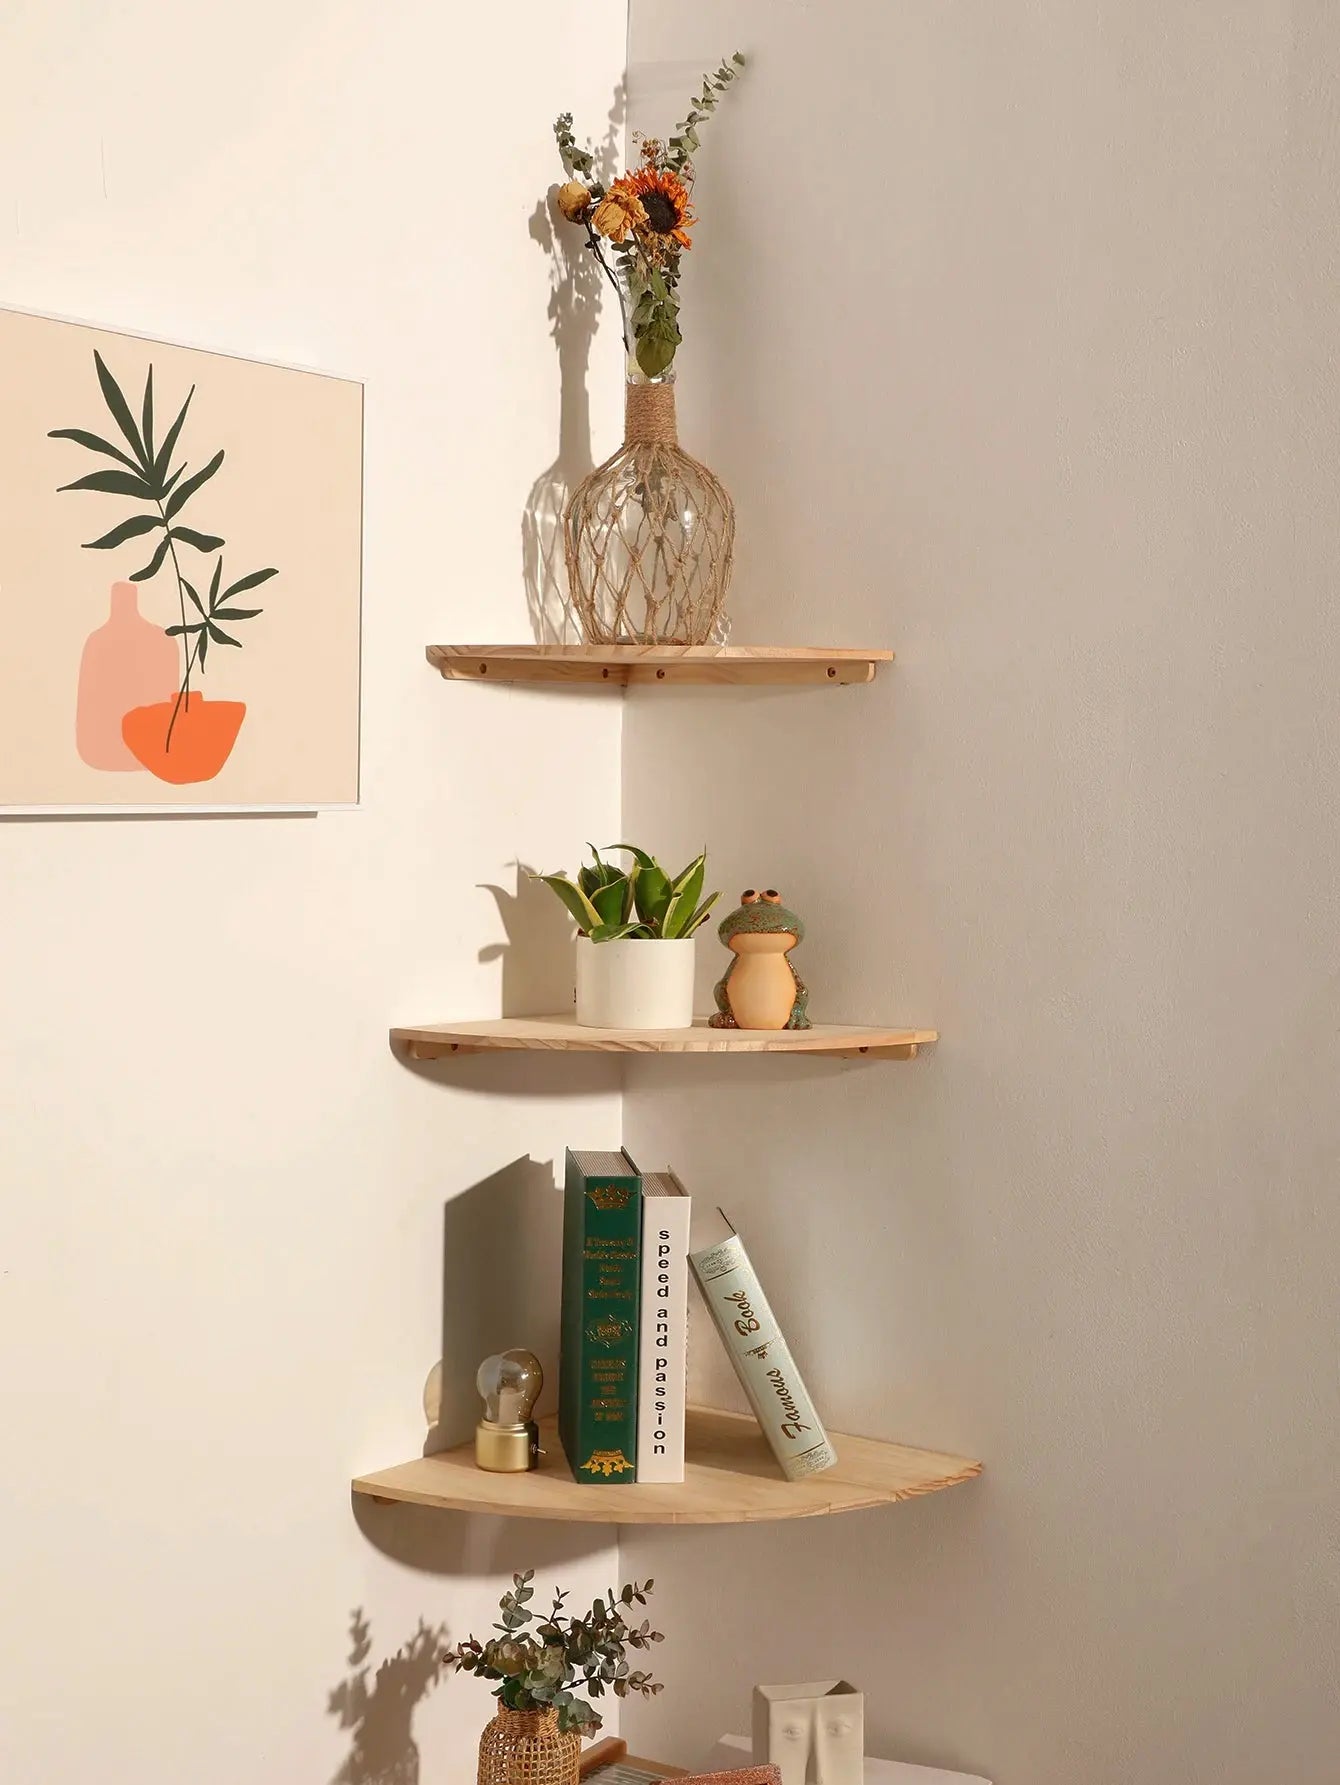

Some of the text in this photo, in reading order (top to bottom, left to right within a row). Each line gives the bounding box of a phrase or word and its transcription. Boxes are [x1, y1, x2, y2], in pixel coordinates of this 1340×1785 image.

[653, 1229, 671, 1454] speed and passion
[723, 1290, 811, 1440] Famous Book
